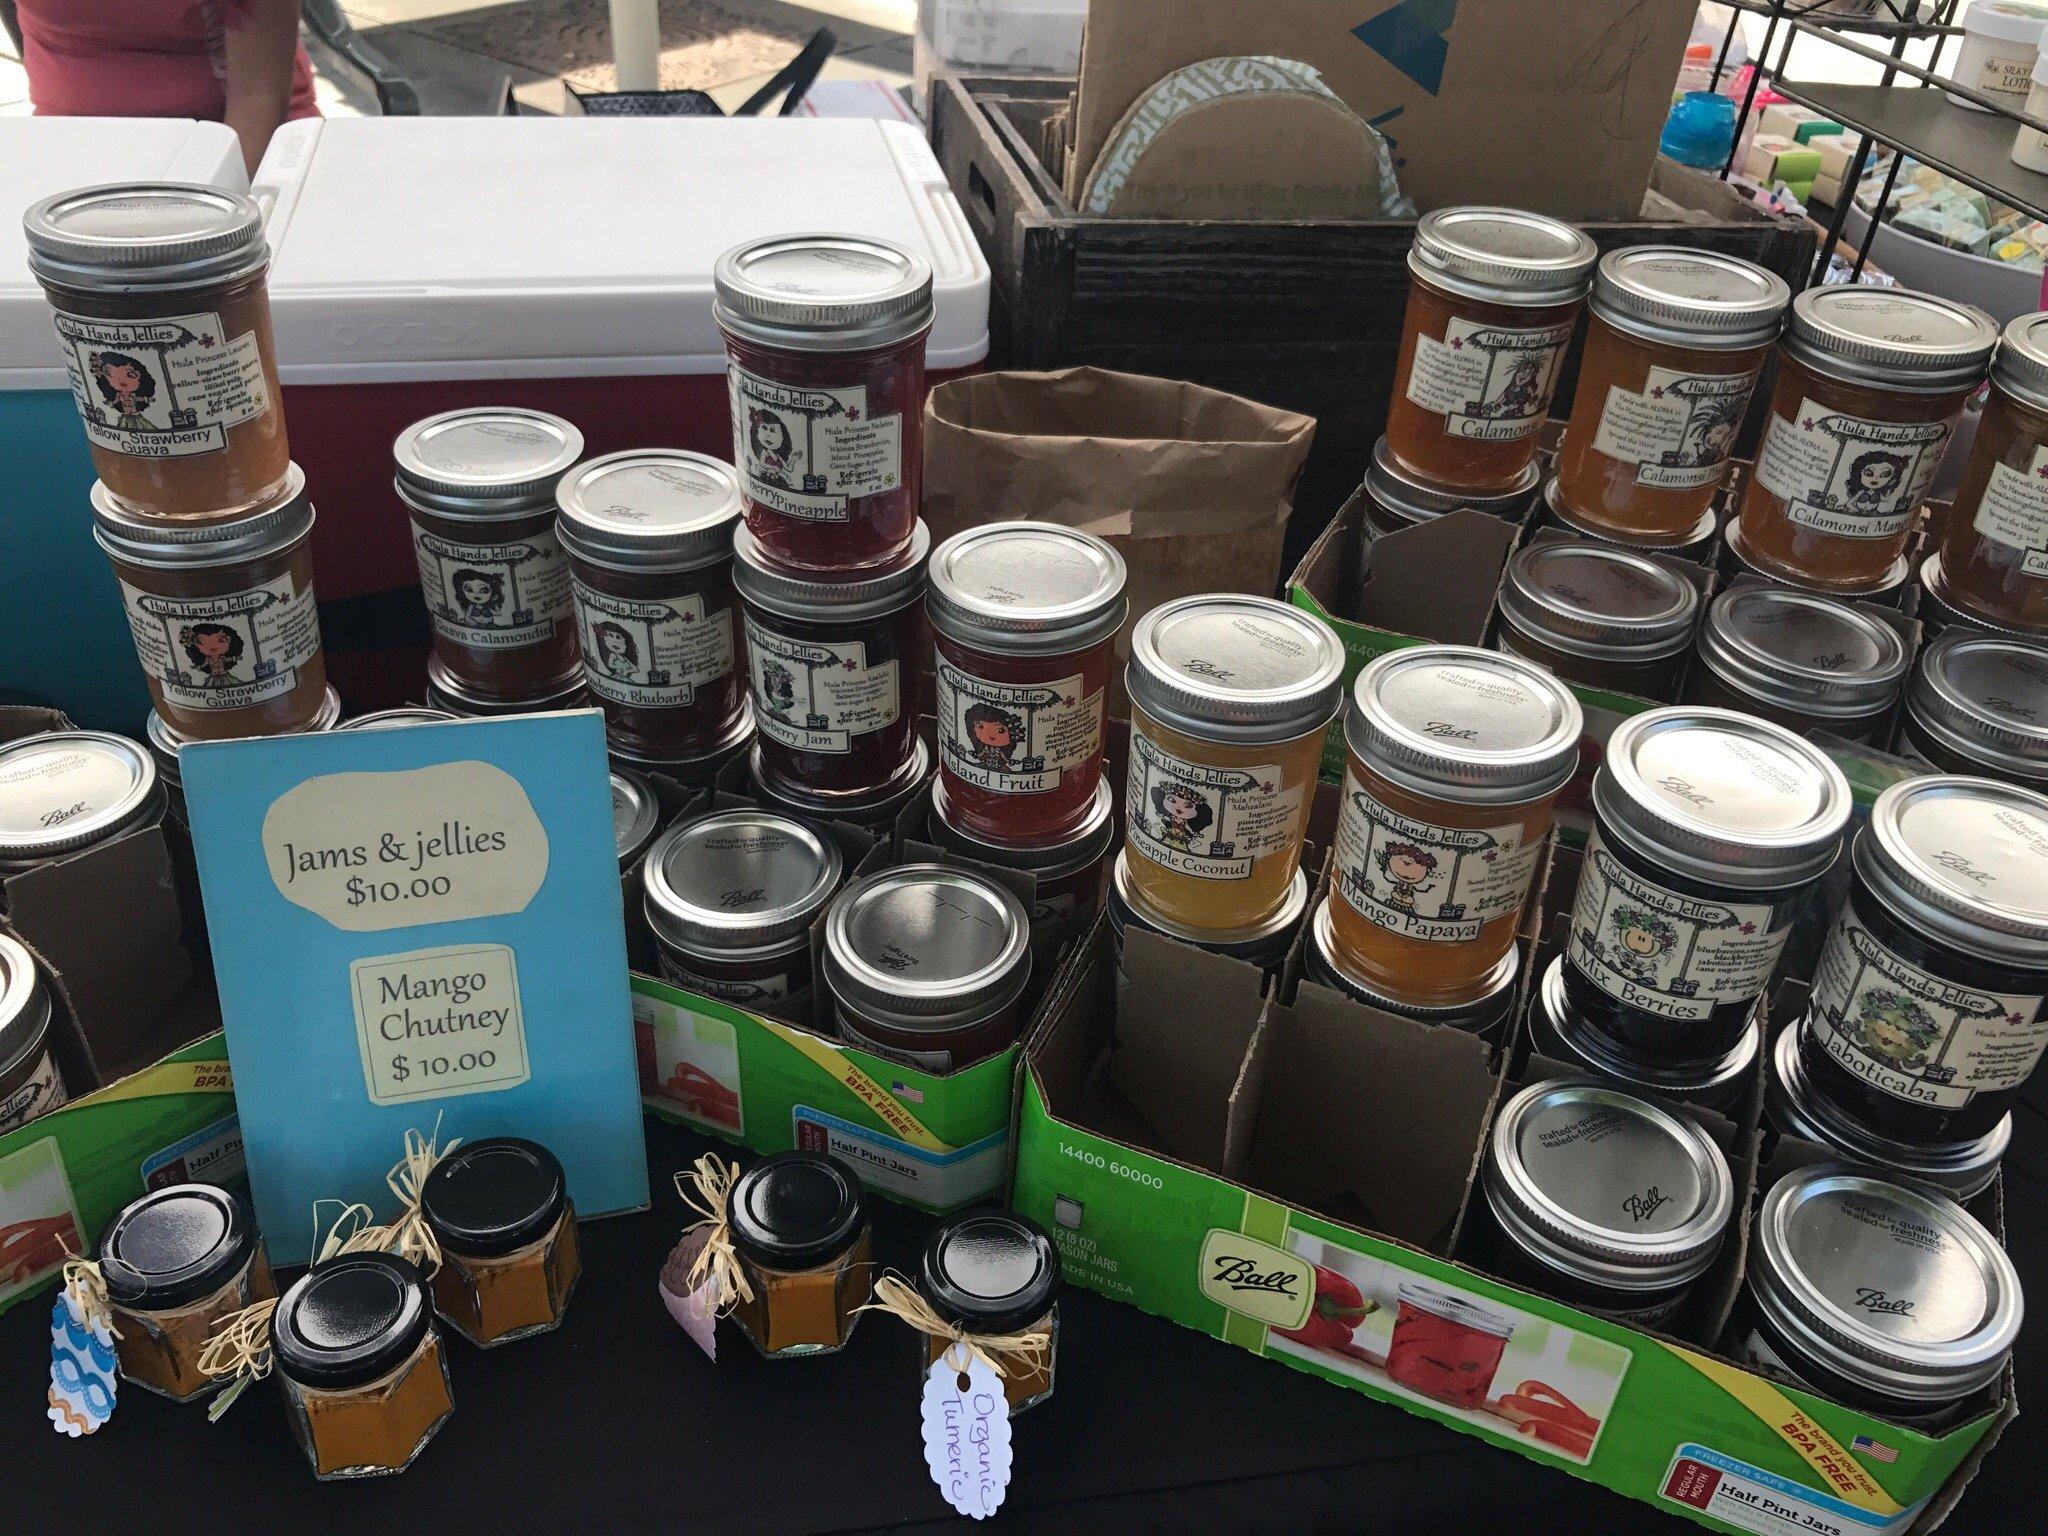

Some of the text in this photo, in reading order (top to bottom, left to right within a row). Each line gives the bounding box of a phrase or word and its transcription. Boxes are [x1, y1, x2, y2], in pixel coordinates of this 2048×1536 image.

[61, 320, 173, 342] Hula Hands Jellies
[1486, 334, 1546, 346] Hula Hands
[196, 359, 239, 376] Ingredients
[207, 390, 247, 407] Refrigerate
[751, 381, 824, 407] Hands Jellies
[1687, 381, 1715, 392] Hula
[130, 429, 211, 445] Strawberry
[835, 433, 876, 444] Ingredients
[1836, 420, 1940, 442] Hula Hands Jellies
[122, 441, 169, 455] Guava
[836, 475, 882, 488] after opening
[840, 468, 878, 479] Refrigerate
[1794, 507, 1870, 534] Calamonsi
[428, 538, 523, 560] Hula Hands Jellies
[150, 595, 261, 615] Hula Hands Jellies
[630, 603, 662, 617] Jellies
[760, 634, 823, 660] Hands Jellies
[1813, 653, 1850, 669] Ball
[167, 676, 286, 699] Yellow Strawberry
[630, 691, 688, 704] Rhubarb
[947, 670, 1045, 703] Hula Hands Jellies
[206, 696, 253, 708] Guava
[803, 732, 833, 746] Jam
[1423, 721, 1478, 740] Ball
[947, 750, 1045, 790] Island Fruit
[1141, 741, 1241, 785] Hula Hands Jellies
[40, 801, 90, 827] Ball
[1249, 804, 1288, 818] Ingredients
[1365, 800, 1479, 846] Hula Hands Jellies
[283, 821, 506, 883] Jams & jellies
[1129, 824, 1246, 874] Pineapple Coconut
[346, 875, 451, 907] $10.00
[721, 889, 766, 907] Ball
[1602, 858, 1627, 887] Hula
[1629, 880, 1674, 911] Hands
[1674, 899, 1720, 920] Jellies
[1342, 879, 1478, 940] Mango Papaya
[1722, 940, 1769, 948] Ingredients
[1578, 950, 1698, 1019] Mix Berries
[1859, 935, 1885, 967] Hula
[1887, 962, 1936, 996] Hands
[1938, 986, 1987, 1012] Jellies
[377, 973, 487, 1004] Mango
[380, 1007, 510, 1041] Chutney
[194, 1065, 211, 1073] The
[391, 1050, 497, 1082] $ 10.00
[1820, 1030, 1938, 1103] Jaboticaba
[194, 1076, 226, 1087] BPA
[844, 1076, 910, 1135] BPA FREE
[846, 1063, 924, 1136] The brand you trust.
[1538, 1125, 1572, 1140] crafted
[1542, 1136, 1573, 1148] sealed
[189, 1150, 220, 1172] Half
[831, 1138, 857, 1155] Half
[860, 1148, 887, 1166] Pint
[891, 1161, 917, 1177] Jars
[1058, 1141, 1163, 1190] 14400 60000
[1622, 1186, 1668, 1222] Ball
[1052, 1228, 1065, 1240] 12
[1899, 1221, 1941, 1239] quality
[1091, 1252, 1118, 1273] JARS
[1090, 1270, 1134, 1296] IN USA
[1212, 1256, 1298, 1296] Ball
[1855, 1288, 1916, 1317] Ball
[942, 1389, 969, 1501] Tumeric
[969, 1393, 996, 1511] Organic
[1780, 1422, 1858, 1492] BPA FREE
[1791, 1411, 1878, 1498] The brand you trust.
[1677, 1464, 1698, 1498] REGULAR
[1694, 1449, 1786, 1489] FREEZER SAFE
[1691, 1472, 1709, 1500] MOUTH
[1720, 1482, 1760, 1504] Half
[1762, 1499, 1799, 1520] Pint
[1802, 1515, 1842, 1536] Jars
